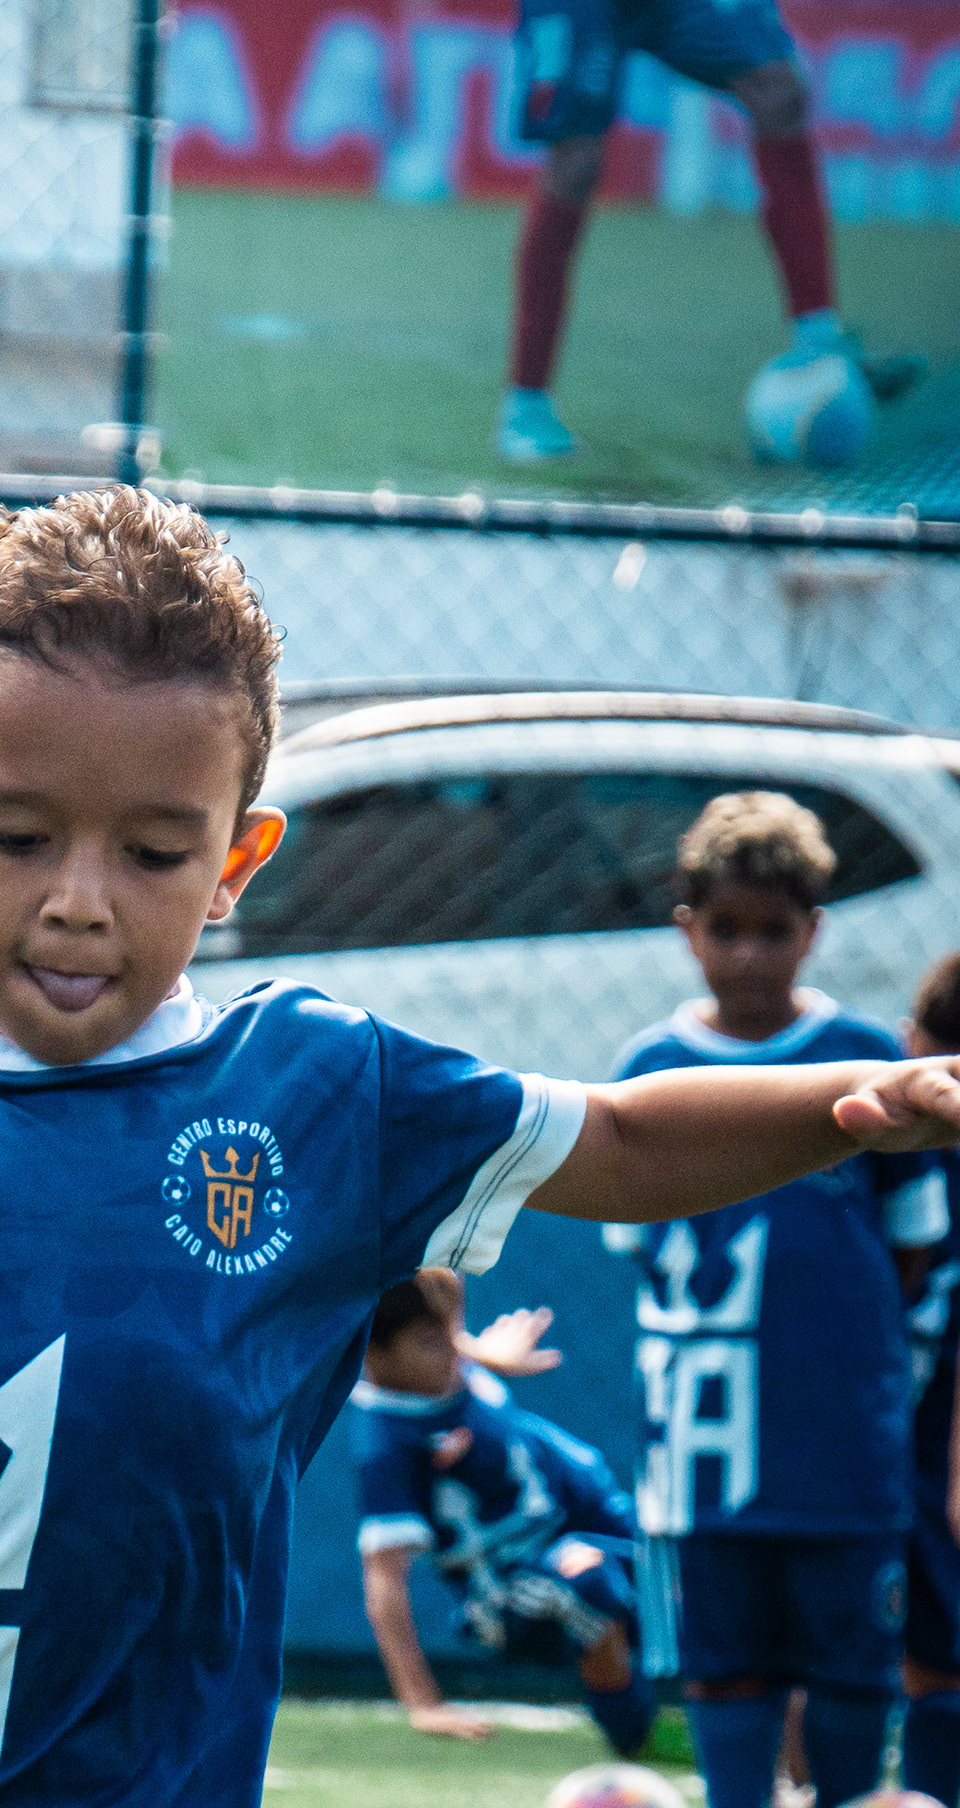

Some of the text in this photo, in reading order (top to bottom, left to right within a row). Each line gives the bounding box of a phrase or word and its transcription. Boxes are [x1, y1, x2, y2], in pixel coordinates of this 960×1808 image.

[167, 1117, 284, 1177] CENTRO ESPORTIVO
[165, 1213, 293, 1276] CAIO ALEXANDRE
[207, 1182, 254, 1249] CA
